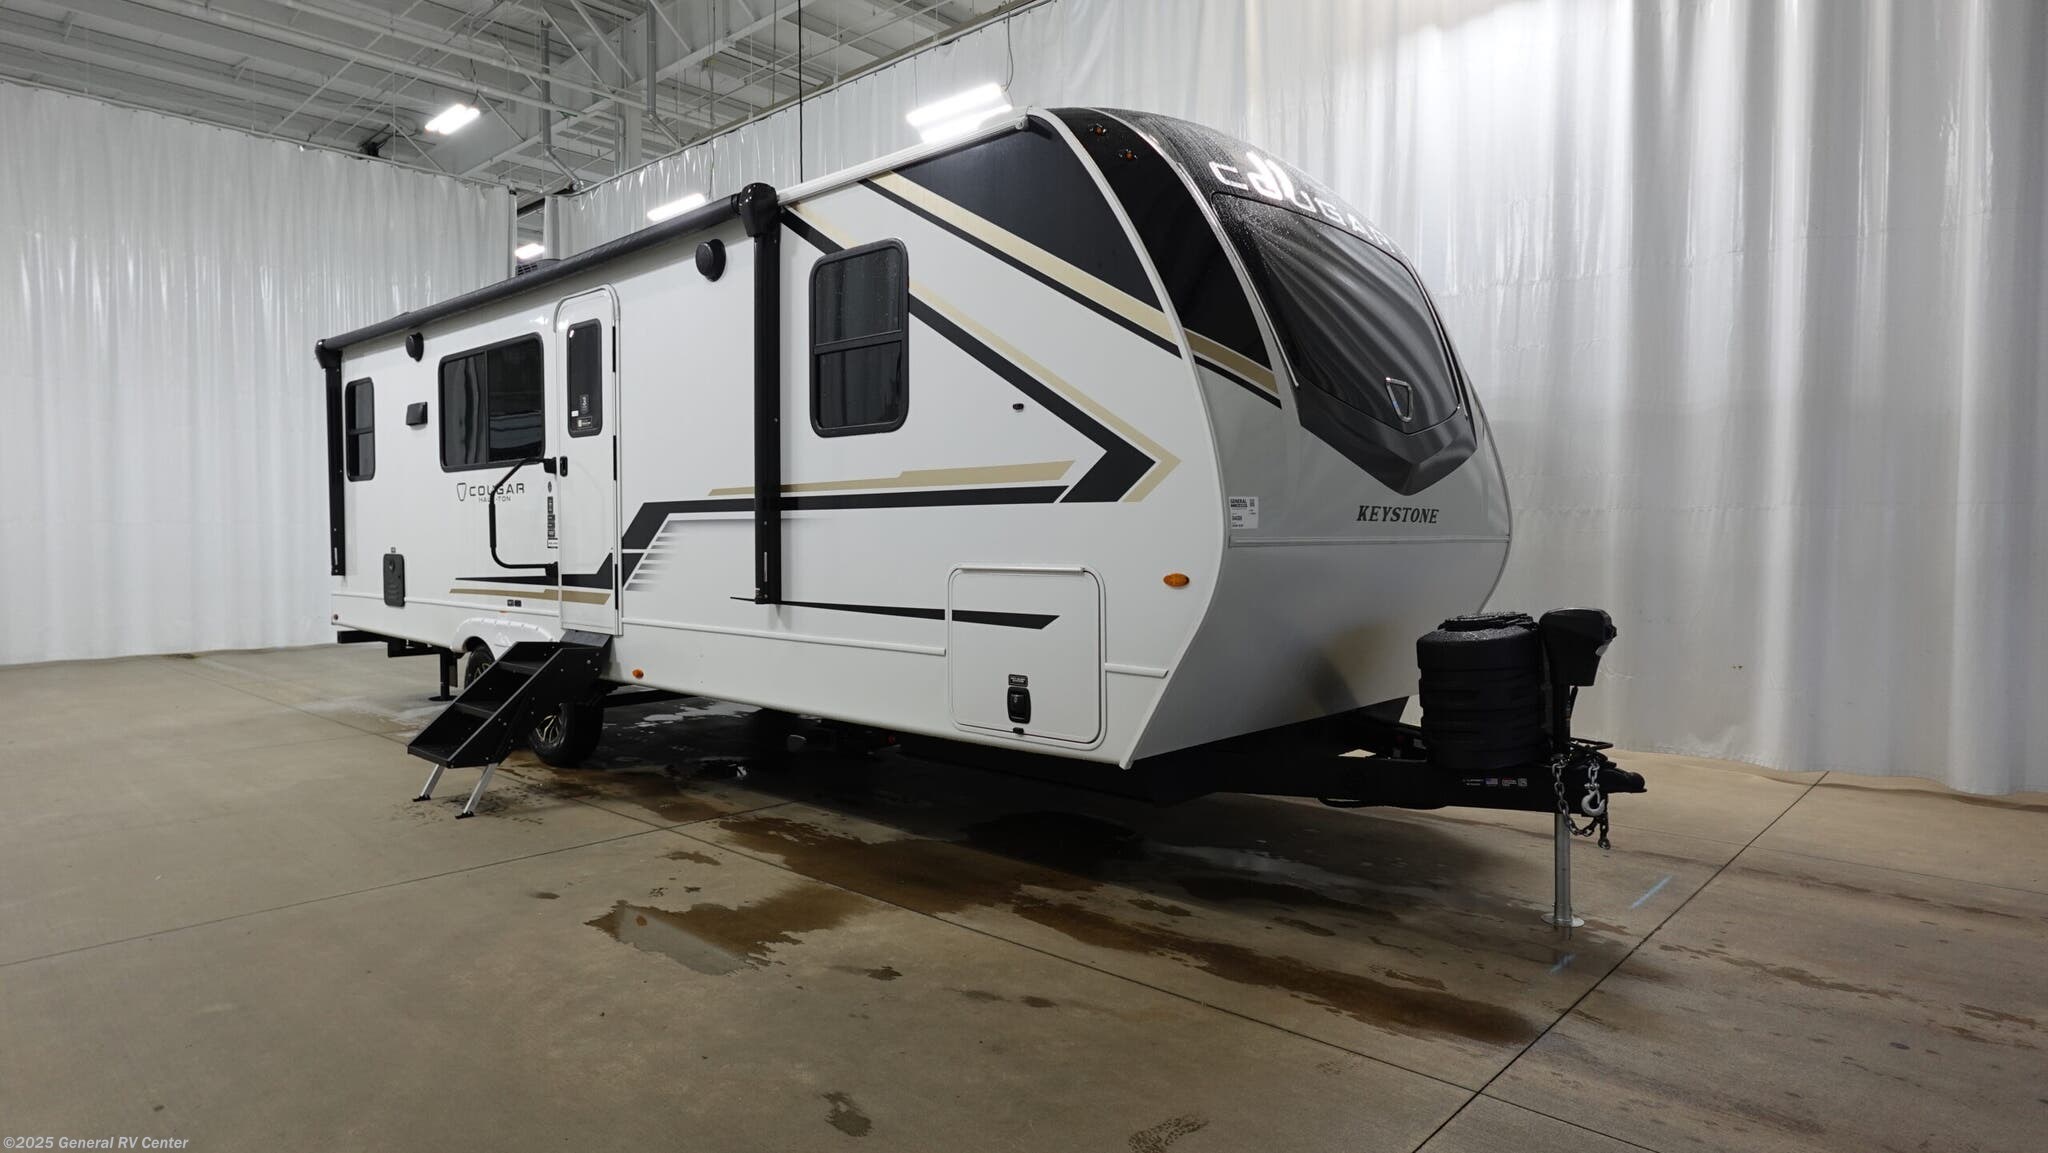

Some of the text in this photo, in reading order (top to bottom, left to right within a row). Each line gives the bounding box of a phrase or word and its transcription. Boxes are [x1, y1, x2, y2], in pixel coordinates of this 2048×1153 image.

[1209, 151, 1395, 253] COUGAR
[469, 482, 525, 496] COUGAR
[478, 495, 512, 503] HAL-TON
[1356, 505, 1440, 524] KEYSTONE
